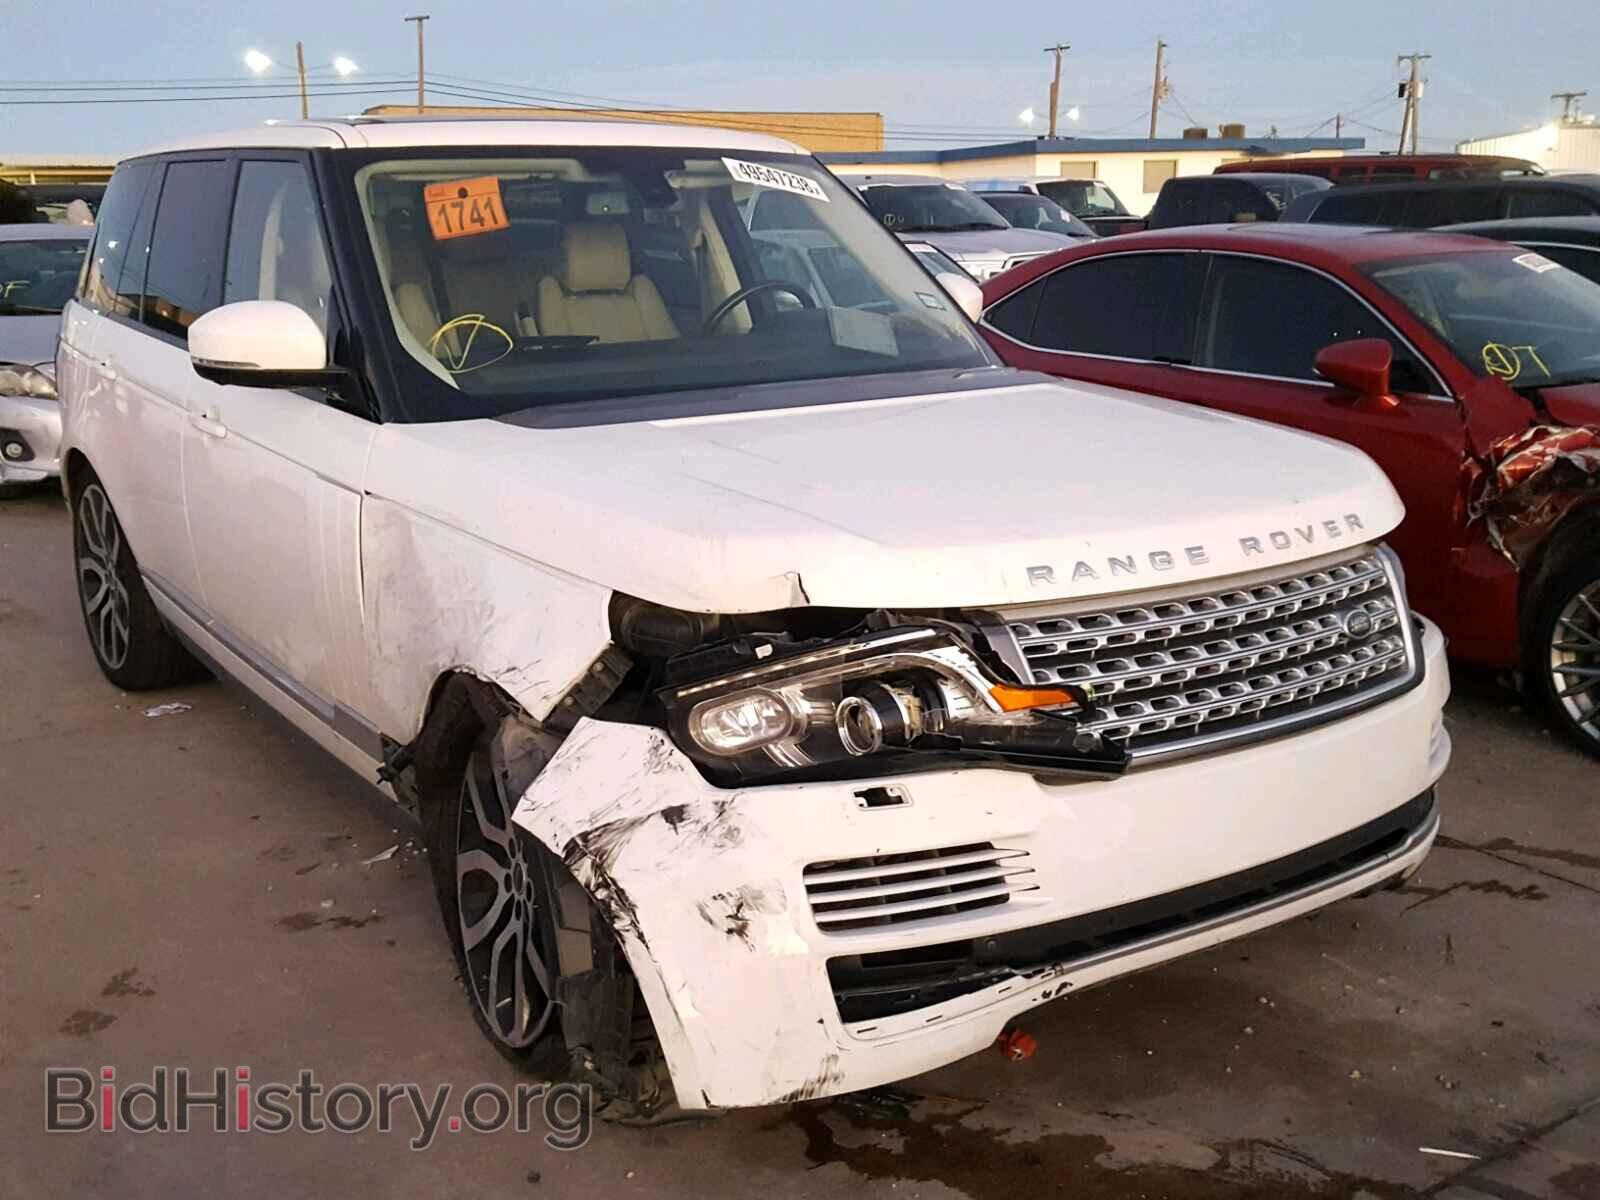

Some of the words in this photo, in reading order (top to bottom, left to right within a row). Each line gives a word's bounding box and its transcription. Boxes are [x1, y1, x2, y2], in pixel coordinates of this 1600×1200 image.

[437, 197, 498, 232] 1741
[1026, 545, 1210, 587] RANGE
[1238, 513, 1365, 557] ROVER
